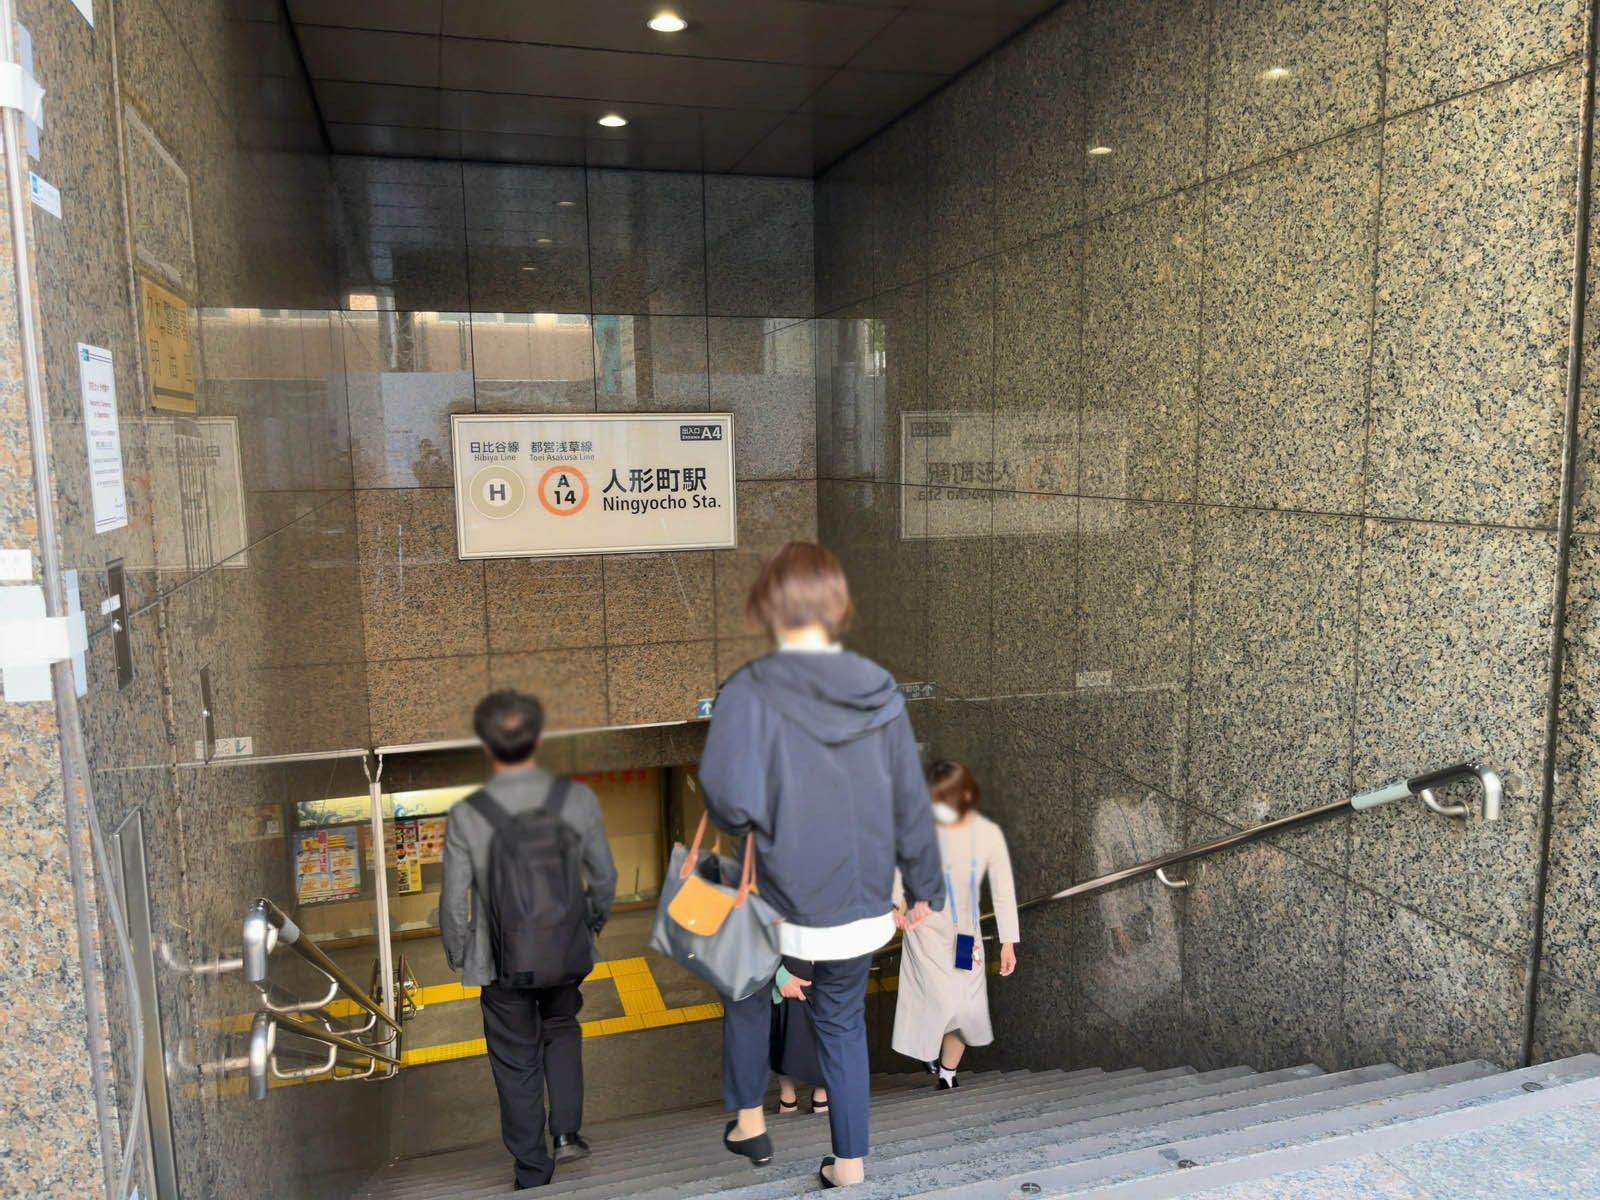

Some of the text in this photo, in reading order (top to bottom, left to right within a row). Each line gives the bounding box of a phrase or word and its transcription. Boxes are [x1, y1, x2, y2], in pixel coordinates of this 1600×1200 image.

[701, 426, 721, 439] A4
[470, 441, 520, 453] 日比谷線
[531, 441, 593, 453] 都営浅草線
[474, 454, 498, 462] Hibiya
[546, 453, 578, 461] Asakusa
[557, 474, 570, 488] A
[602, 467, 707, 493] 人形町駅
[489, 484, 506, 501] H
[554, 490, 576, 505] 14
[603, 494, 721, 514] Ningyocho Sta.
